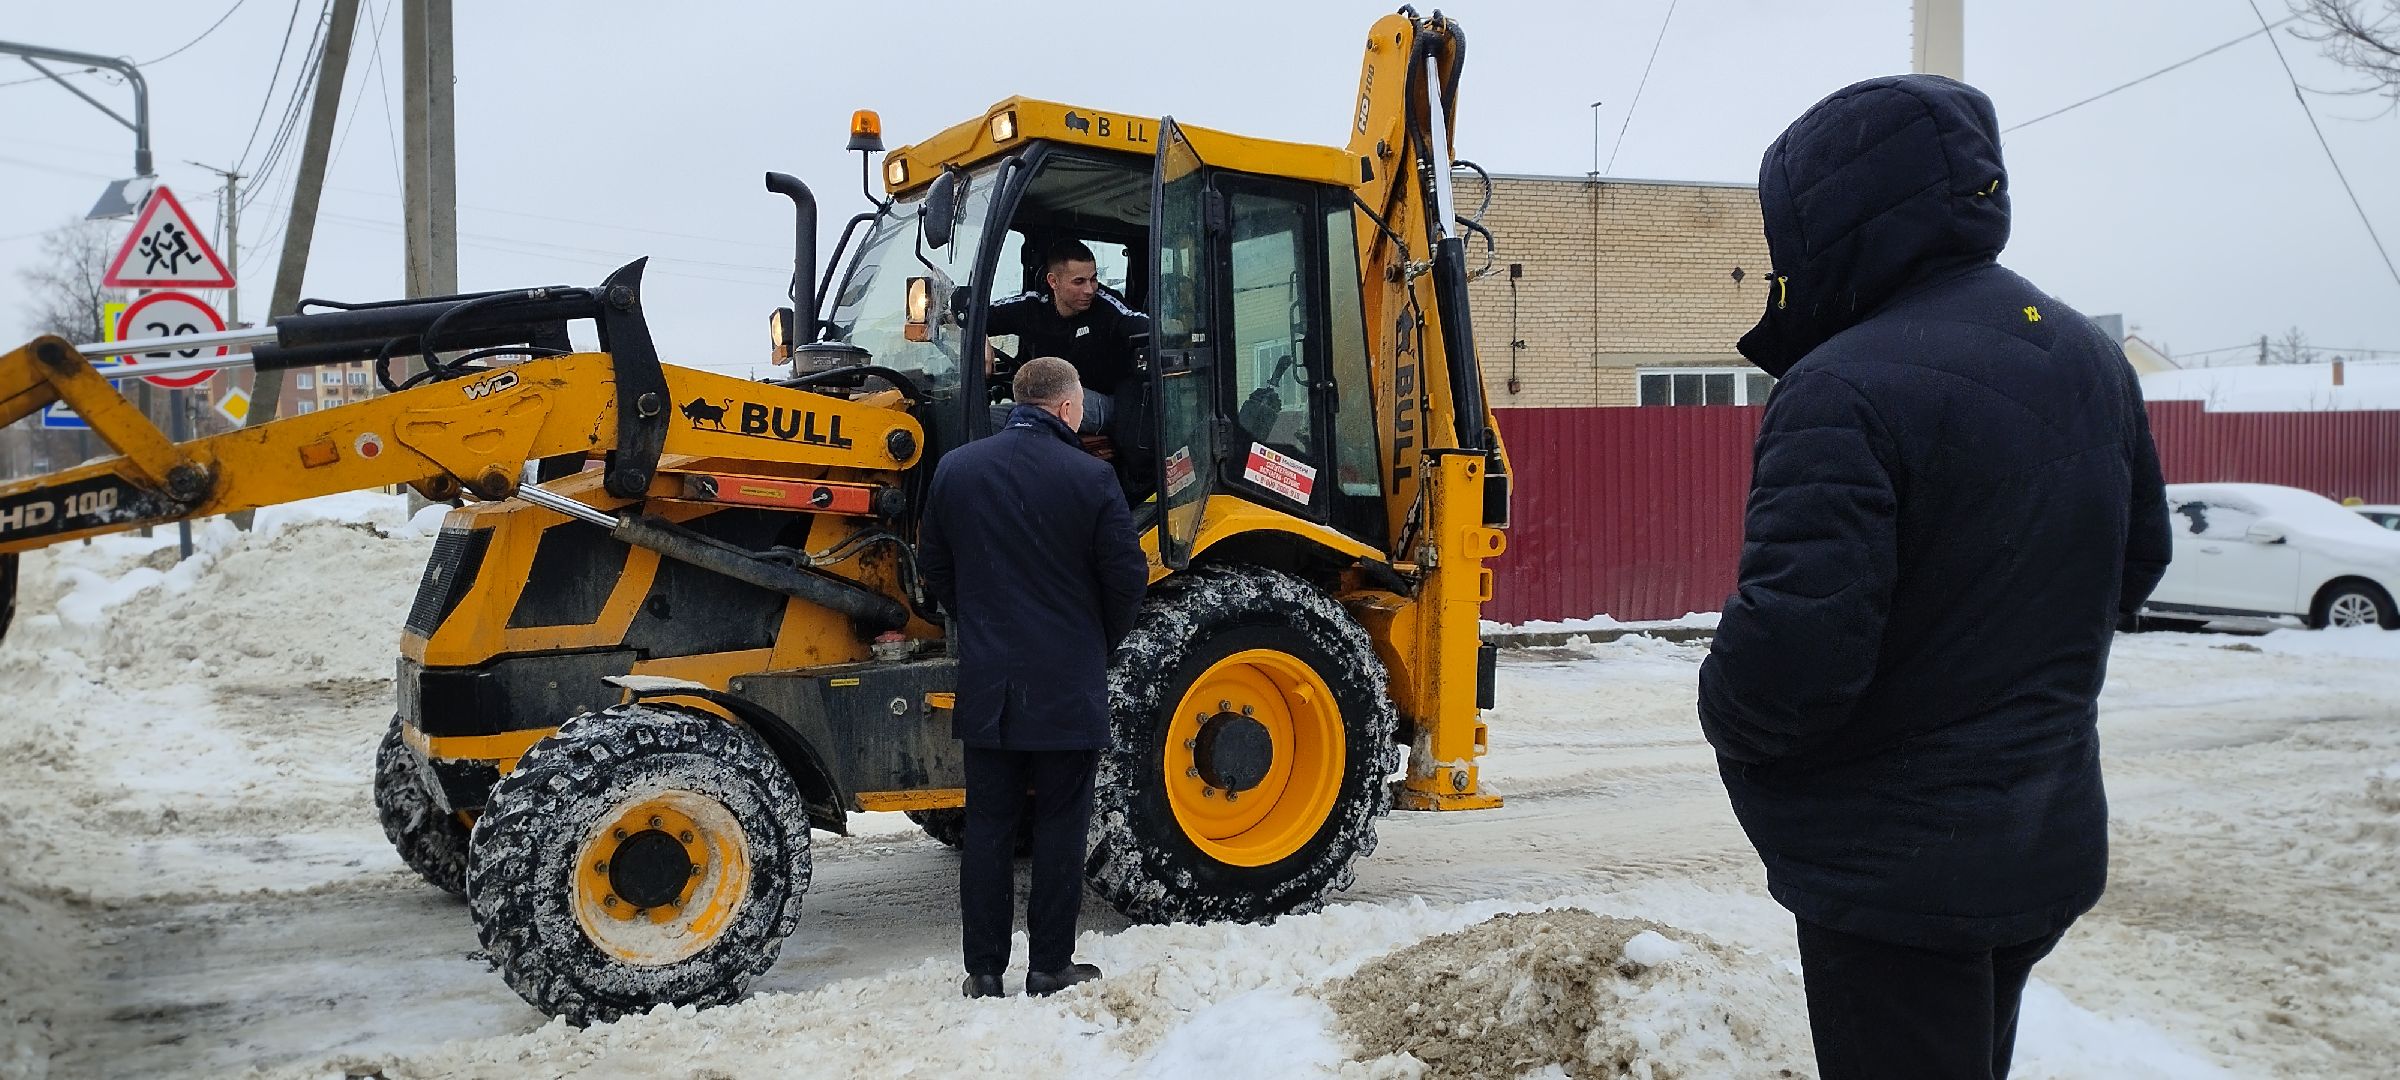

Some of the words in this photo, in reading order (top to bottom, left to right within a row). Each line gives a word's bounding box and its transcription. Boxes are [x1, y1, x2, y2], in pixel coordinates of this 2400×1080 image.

[145, 322, 200, 358] 20
[462, 370, 520, 400] WD
[740, 402, 853, 448] BULL
[1393, 364, 1415, 495] BULL
[0, 500, 55, 533] HD
[64, 487, 118, 519] 100
